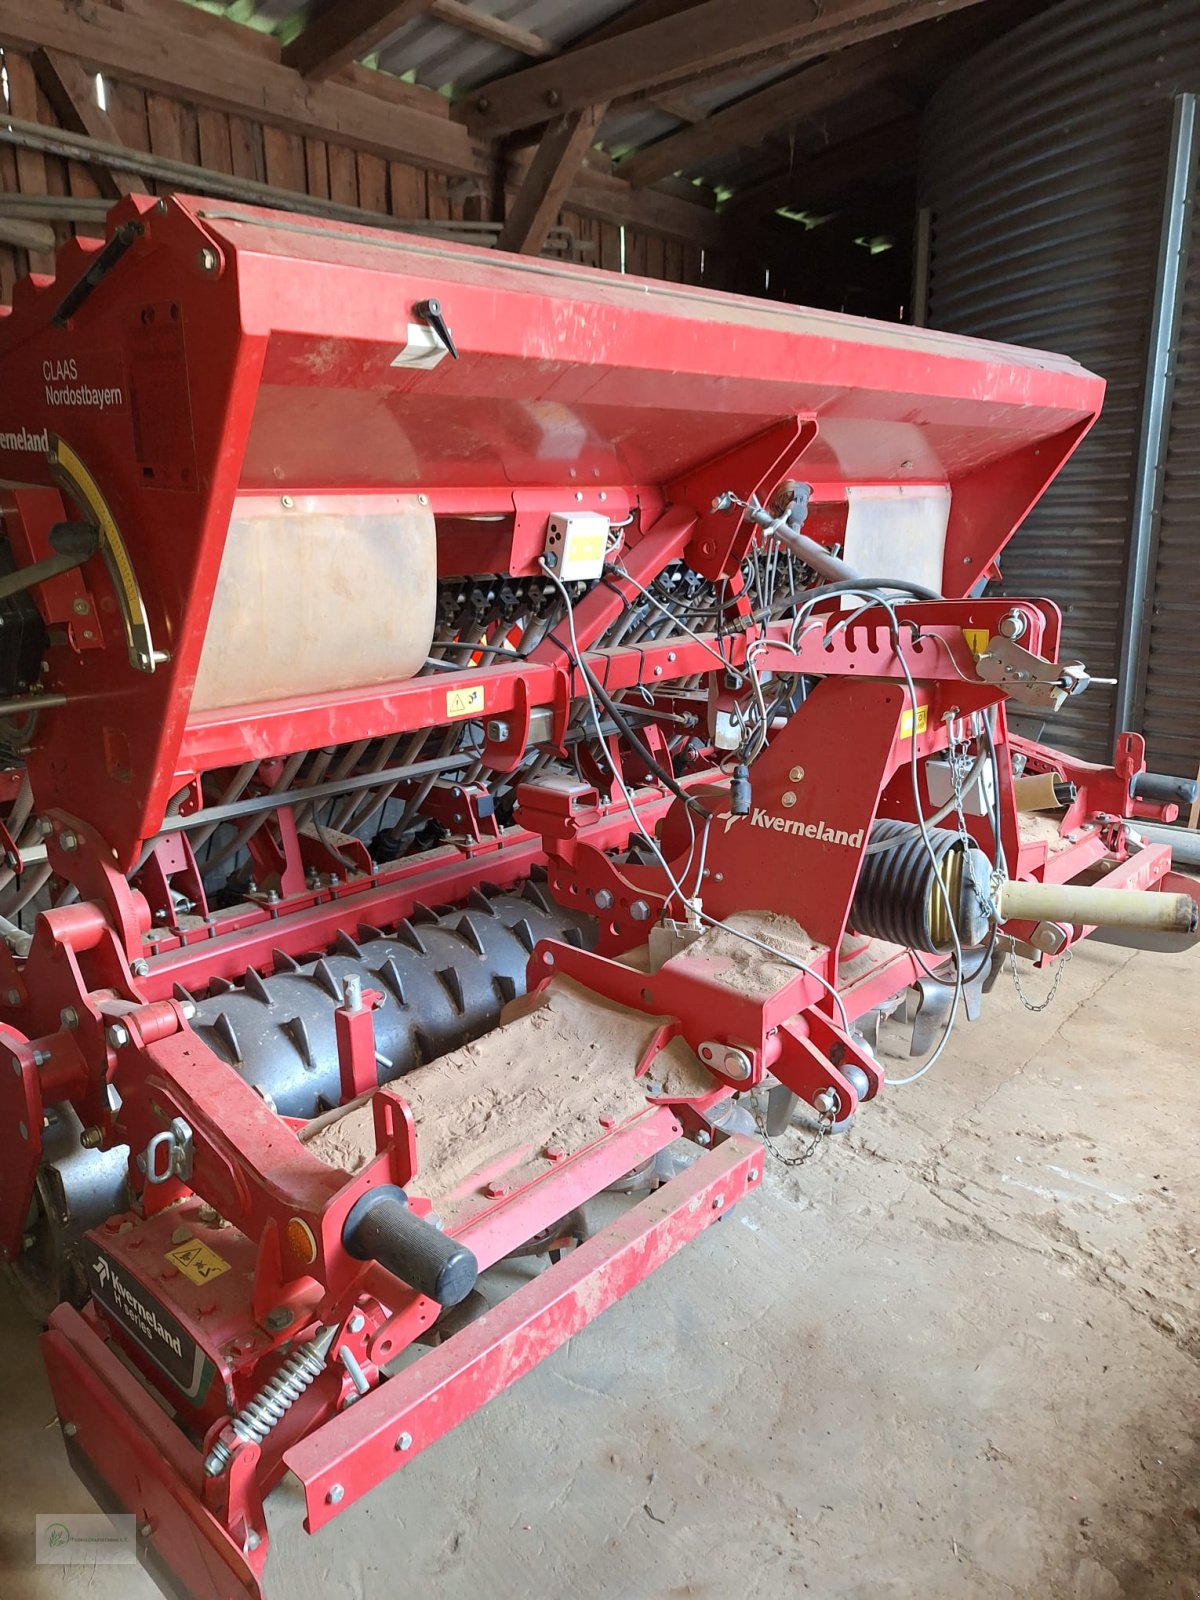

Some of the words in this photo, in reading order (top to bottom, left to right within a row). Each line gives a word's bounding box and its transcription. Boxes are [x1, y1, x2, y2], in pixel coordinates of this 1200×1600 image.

[43, 358, 78, 381] CLAAS
[45, 384, 122, 410] Nordostbayern
[750, 808, 865, 849] Kverneland
[111, 1271, 183, 1359] Kverneland
[114, 1290, 122, 1308] H
[124, 1304, 153, 1340] series
